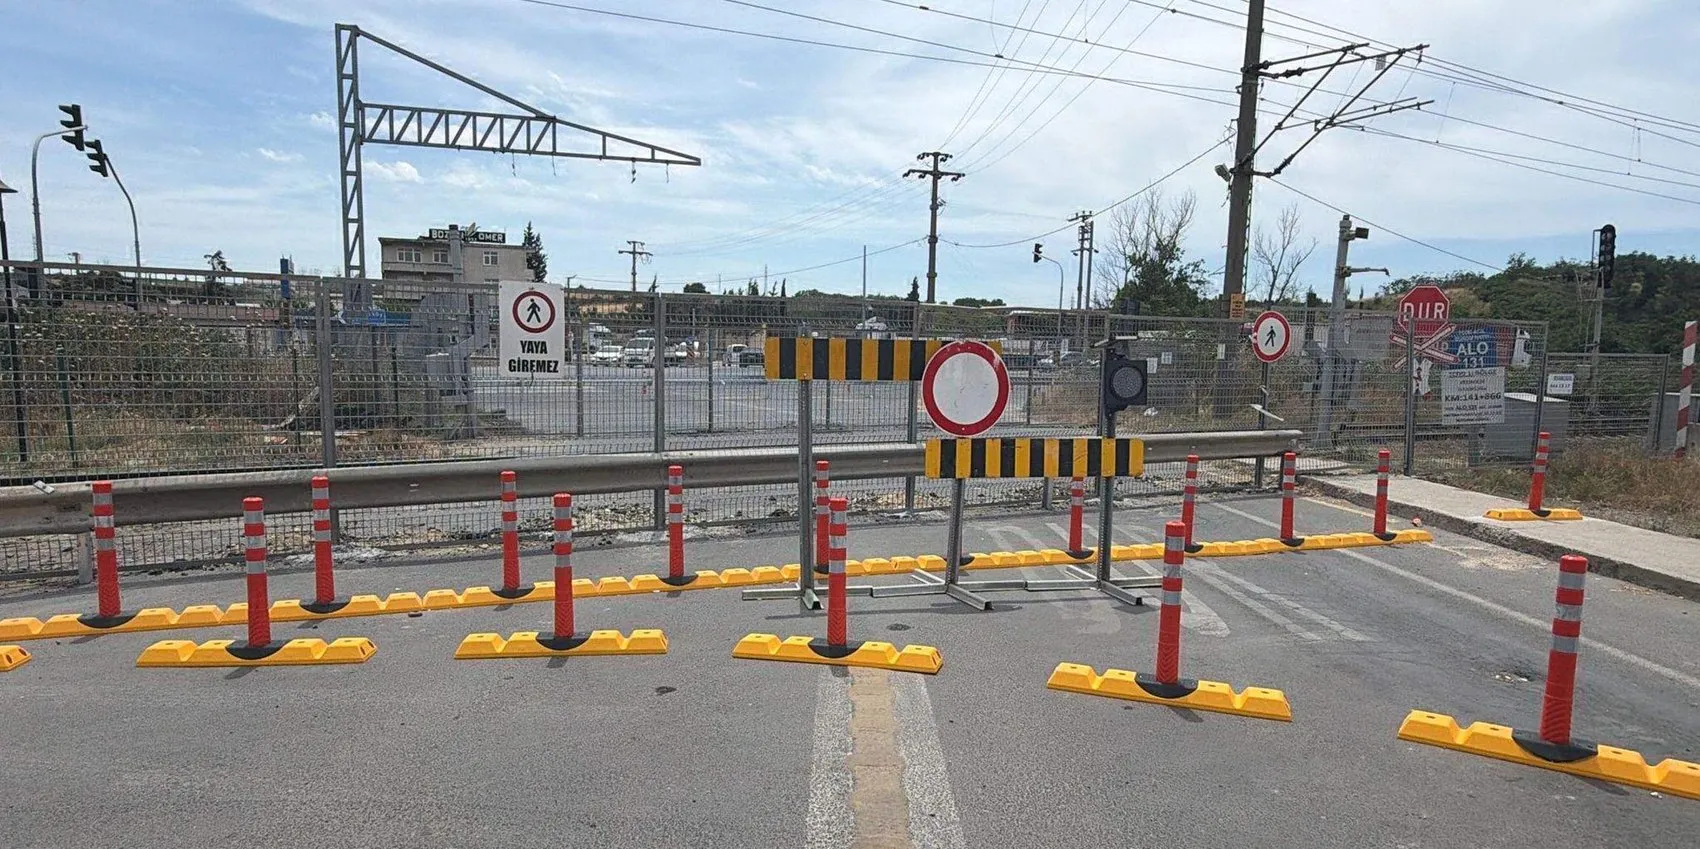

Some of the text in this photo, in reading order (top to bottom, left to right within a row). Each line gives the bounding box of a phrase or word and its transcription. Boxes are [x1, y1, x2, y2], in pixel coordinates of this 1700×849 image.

[1402, 302, 1445, 321] DUR
[520, 340, 548, 354] YAYA
[1457, 341, 1489, 356] ALO
[508, 357, 559, 373] GİREMEZ
[1462, 356, 1484, 368] 131
